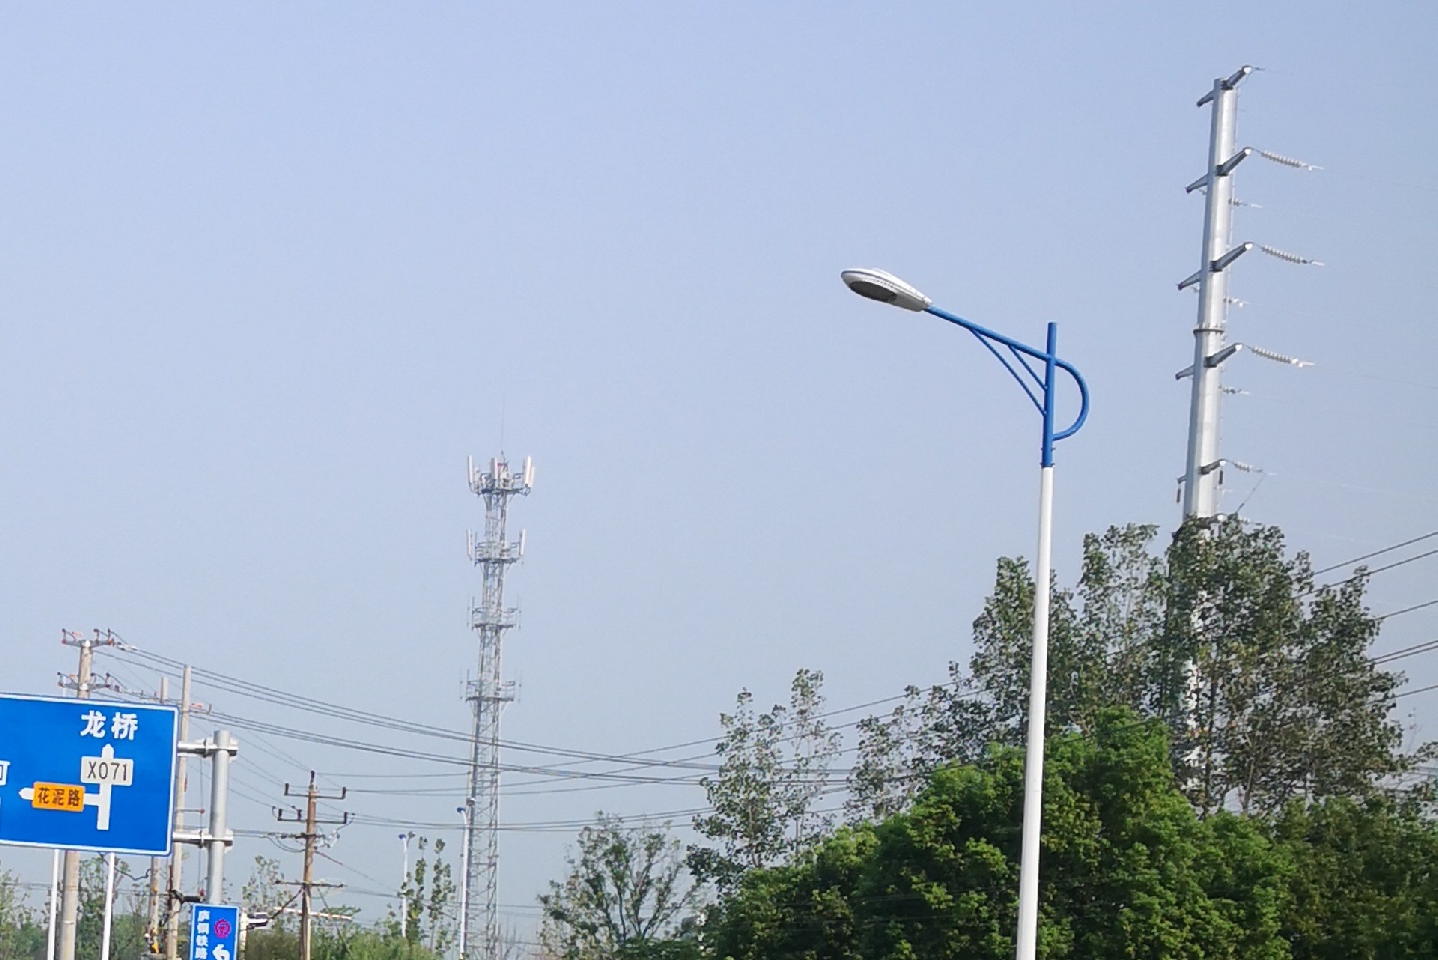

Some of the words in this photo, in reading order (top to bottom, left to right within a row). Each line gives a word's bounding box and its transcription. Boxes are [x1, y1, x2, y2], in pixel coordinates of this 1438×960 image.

[80, 710, 139, 740] 龙桥
[86, 761, 128, 781] X071
[37, 787, 81, 807] 花泥路
